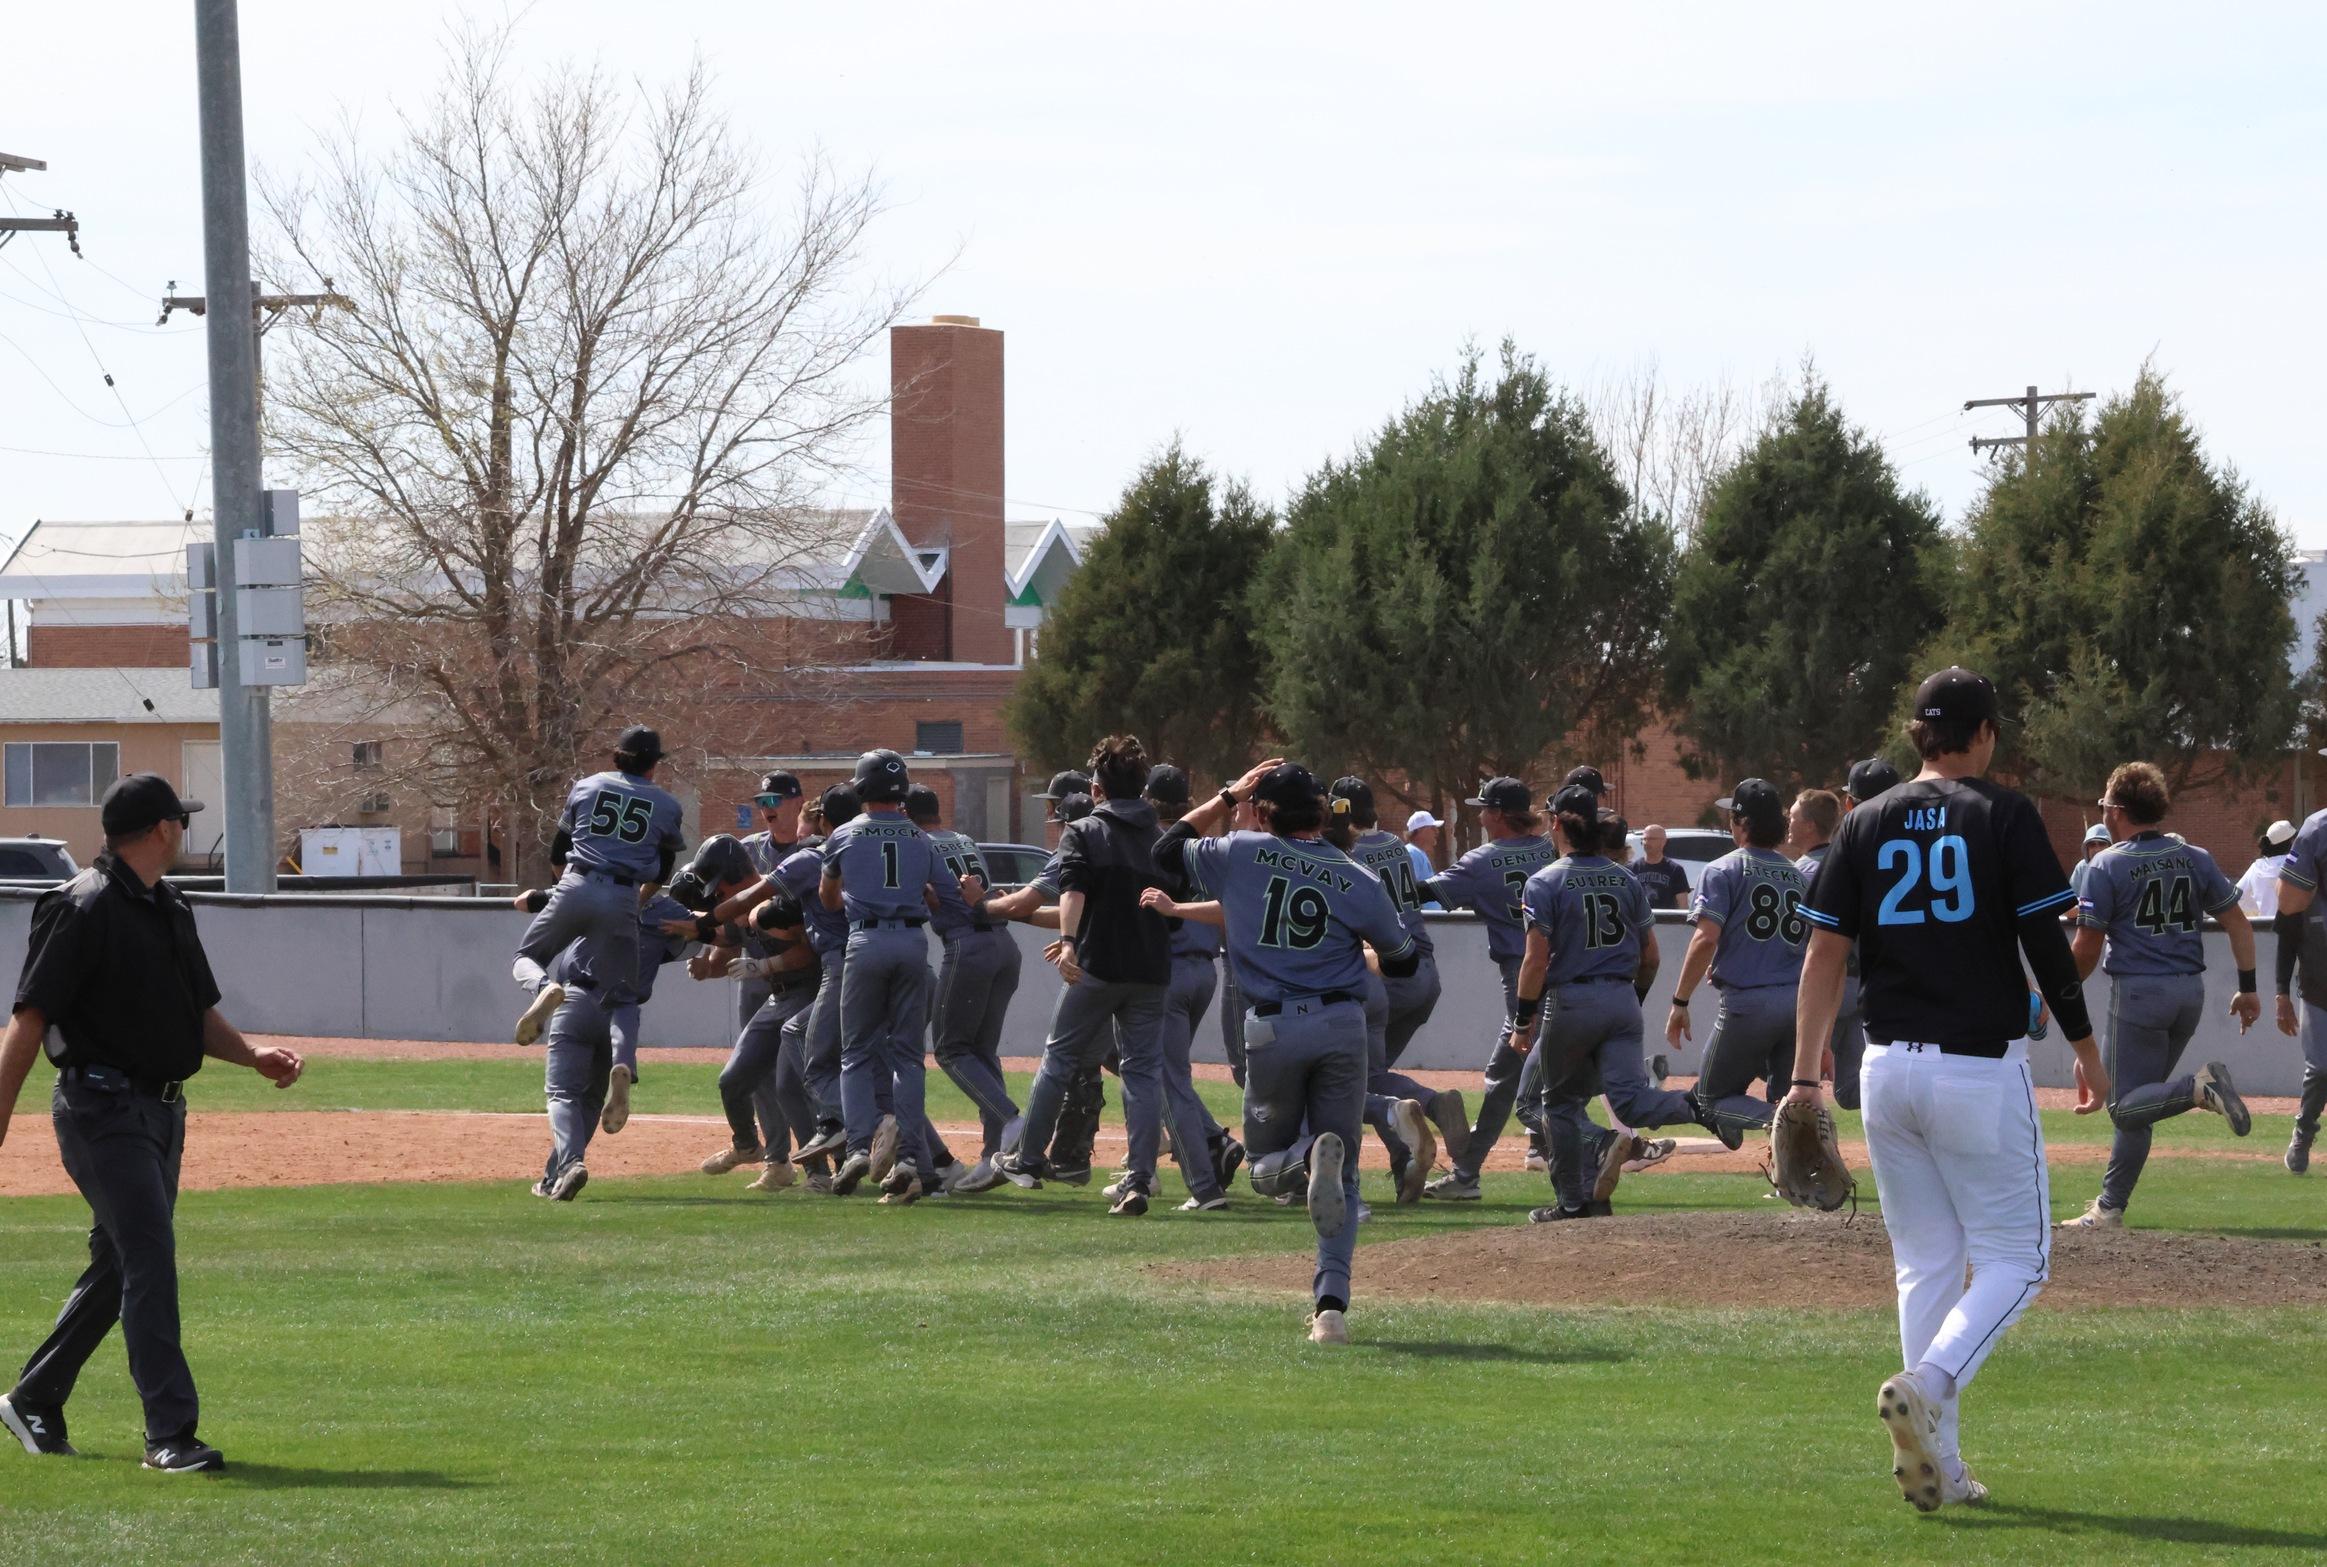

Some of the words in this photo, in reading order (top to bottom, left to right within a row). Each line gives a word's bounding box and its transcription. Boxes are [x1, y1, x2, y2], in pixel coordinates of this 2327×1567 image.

[1925, 708, 1941, 716] CATS
[590, 790, 653, 844] 55
[851, 826, 921, 839] SMOCK
[1904, 806, 1946, 831] JASA
[882, 841, 900, 889] 1
[933, 841, 975, 855] ISBEC
[1255, 848, 1353, 894] MCVAY
[1490, 849, 1558, 870] DENTO
[944, 852, 990, 894] 15
[1378, 861, 1421, 915] 14
[1744, 866, 1808, 891] STECKE
[1877, 835, 1975, 926] 29
[1257, 875, 1331, 951] 19
[1582, 892, 1627, 950] 13
[1745, 882, 1808, 947] 88
[2134, 875, 2198, 936] 44
